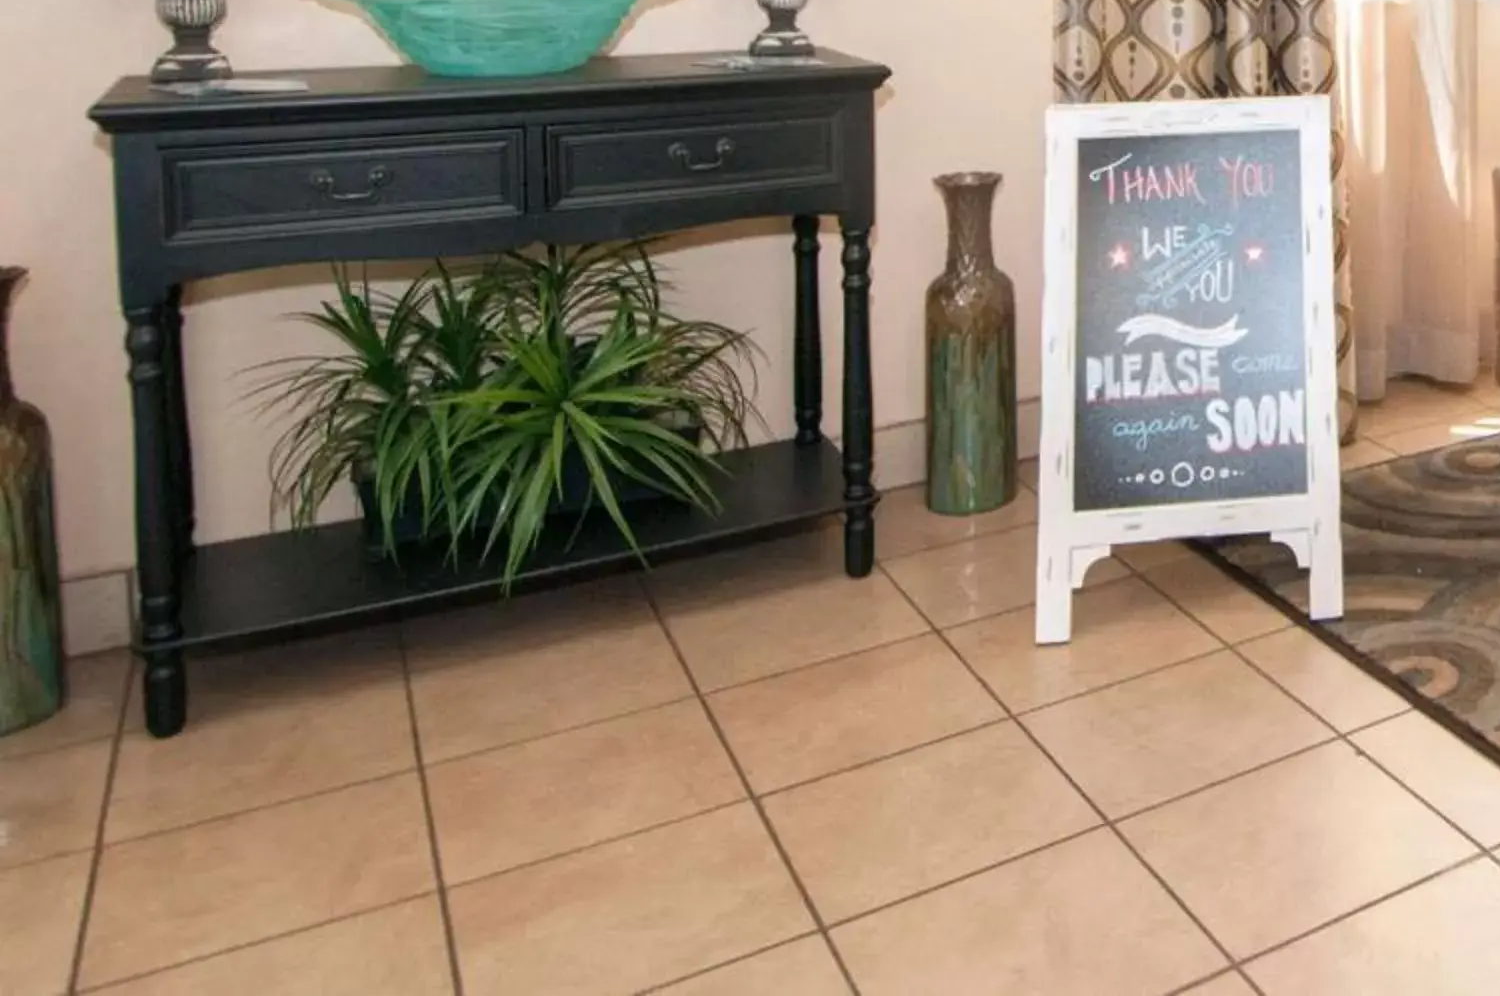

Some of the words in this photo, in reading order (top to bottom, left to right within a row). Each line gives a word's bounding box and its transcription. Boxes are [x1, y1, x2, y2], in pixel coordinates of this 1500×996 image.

[1089, 152, 1206, 204] THANK
[1218, 155, 1274, 211] YOU
[1141, 225, 1186, 260] WE
[1184, 258, 1234, 303] YOU
[1086, 347, 1221, 403] PLEASE
[1112, 410, 1199, 451] again
[1205, 389, 1304, 453] SOON
